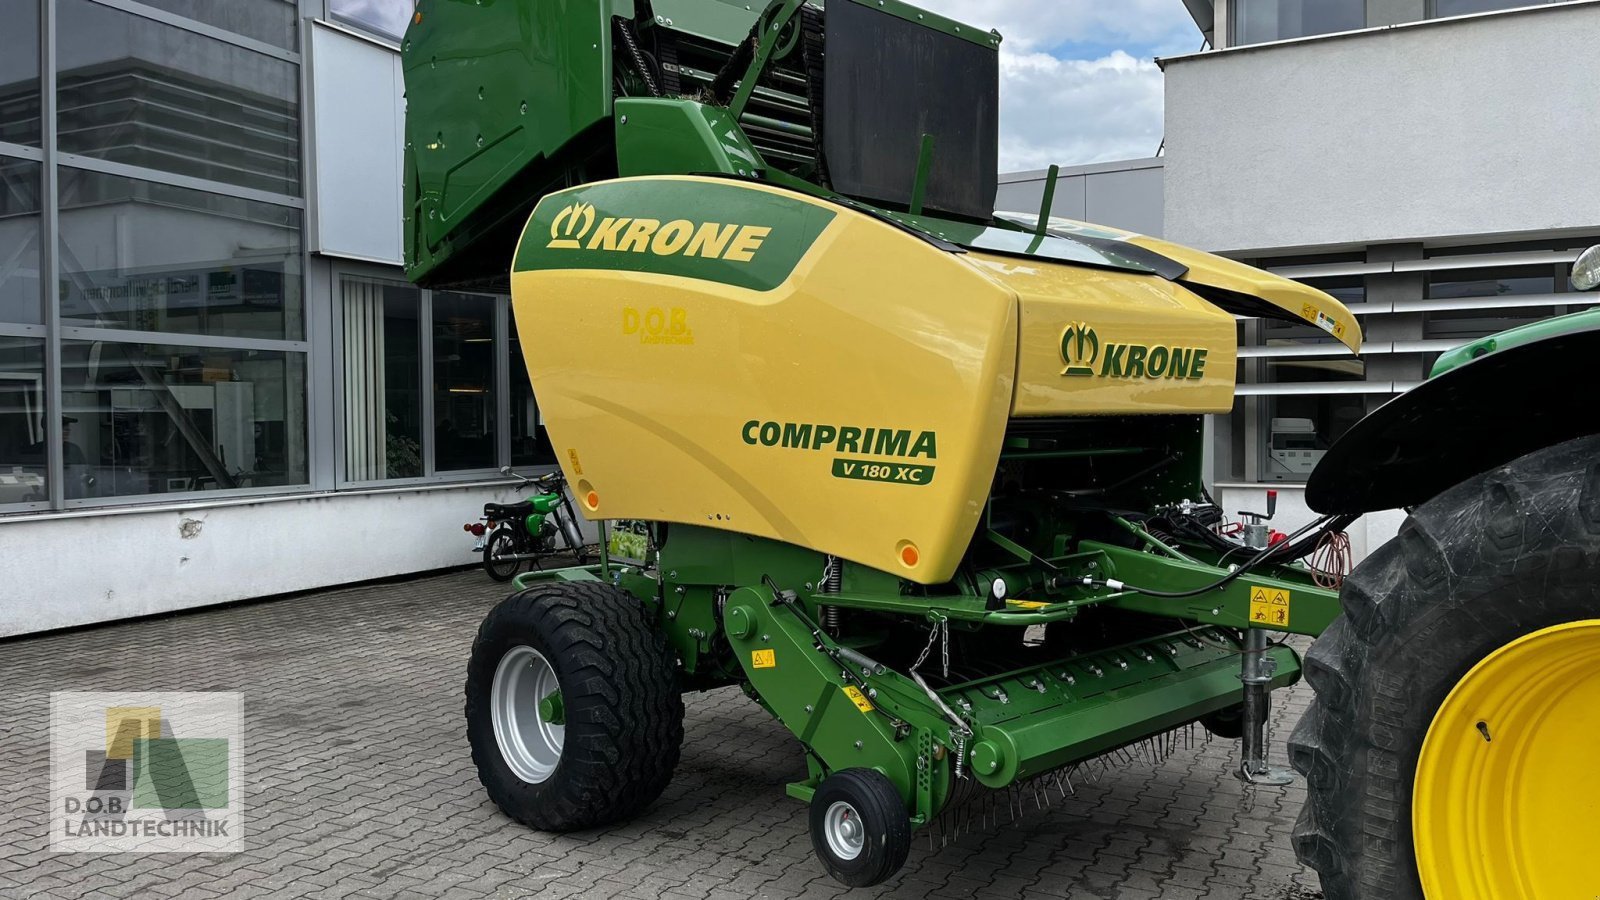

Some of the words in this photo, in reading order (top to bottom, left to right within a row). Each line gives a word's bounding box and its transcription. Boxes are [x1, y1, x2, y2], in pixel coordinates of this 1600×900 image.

[586, 217, 772, 262] KRONE
[623, 307, 692, 336] D.O.B.
[1098, 342, 1208, 379] KRONE
[741, 420, 937, 459] COMPRIMA
[843, 462, 855, 476] V
[861, 464, 891, 479] 180
[895, 467, 923, 482] XC
